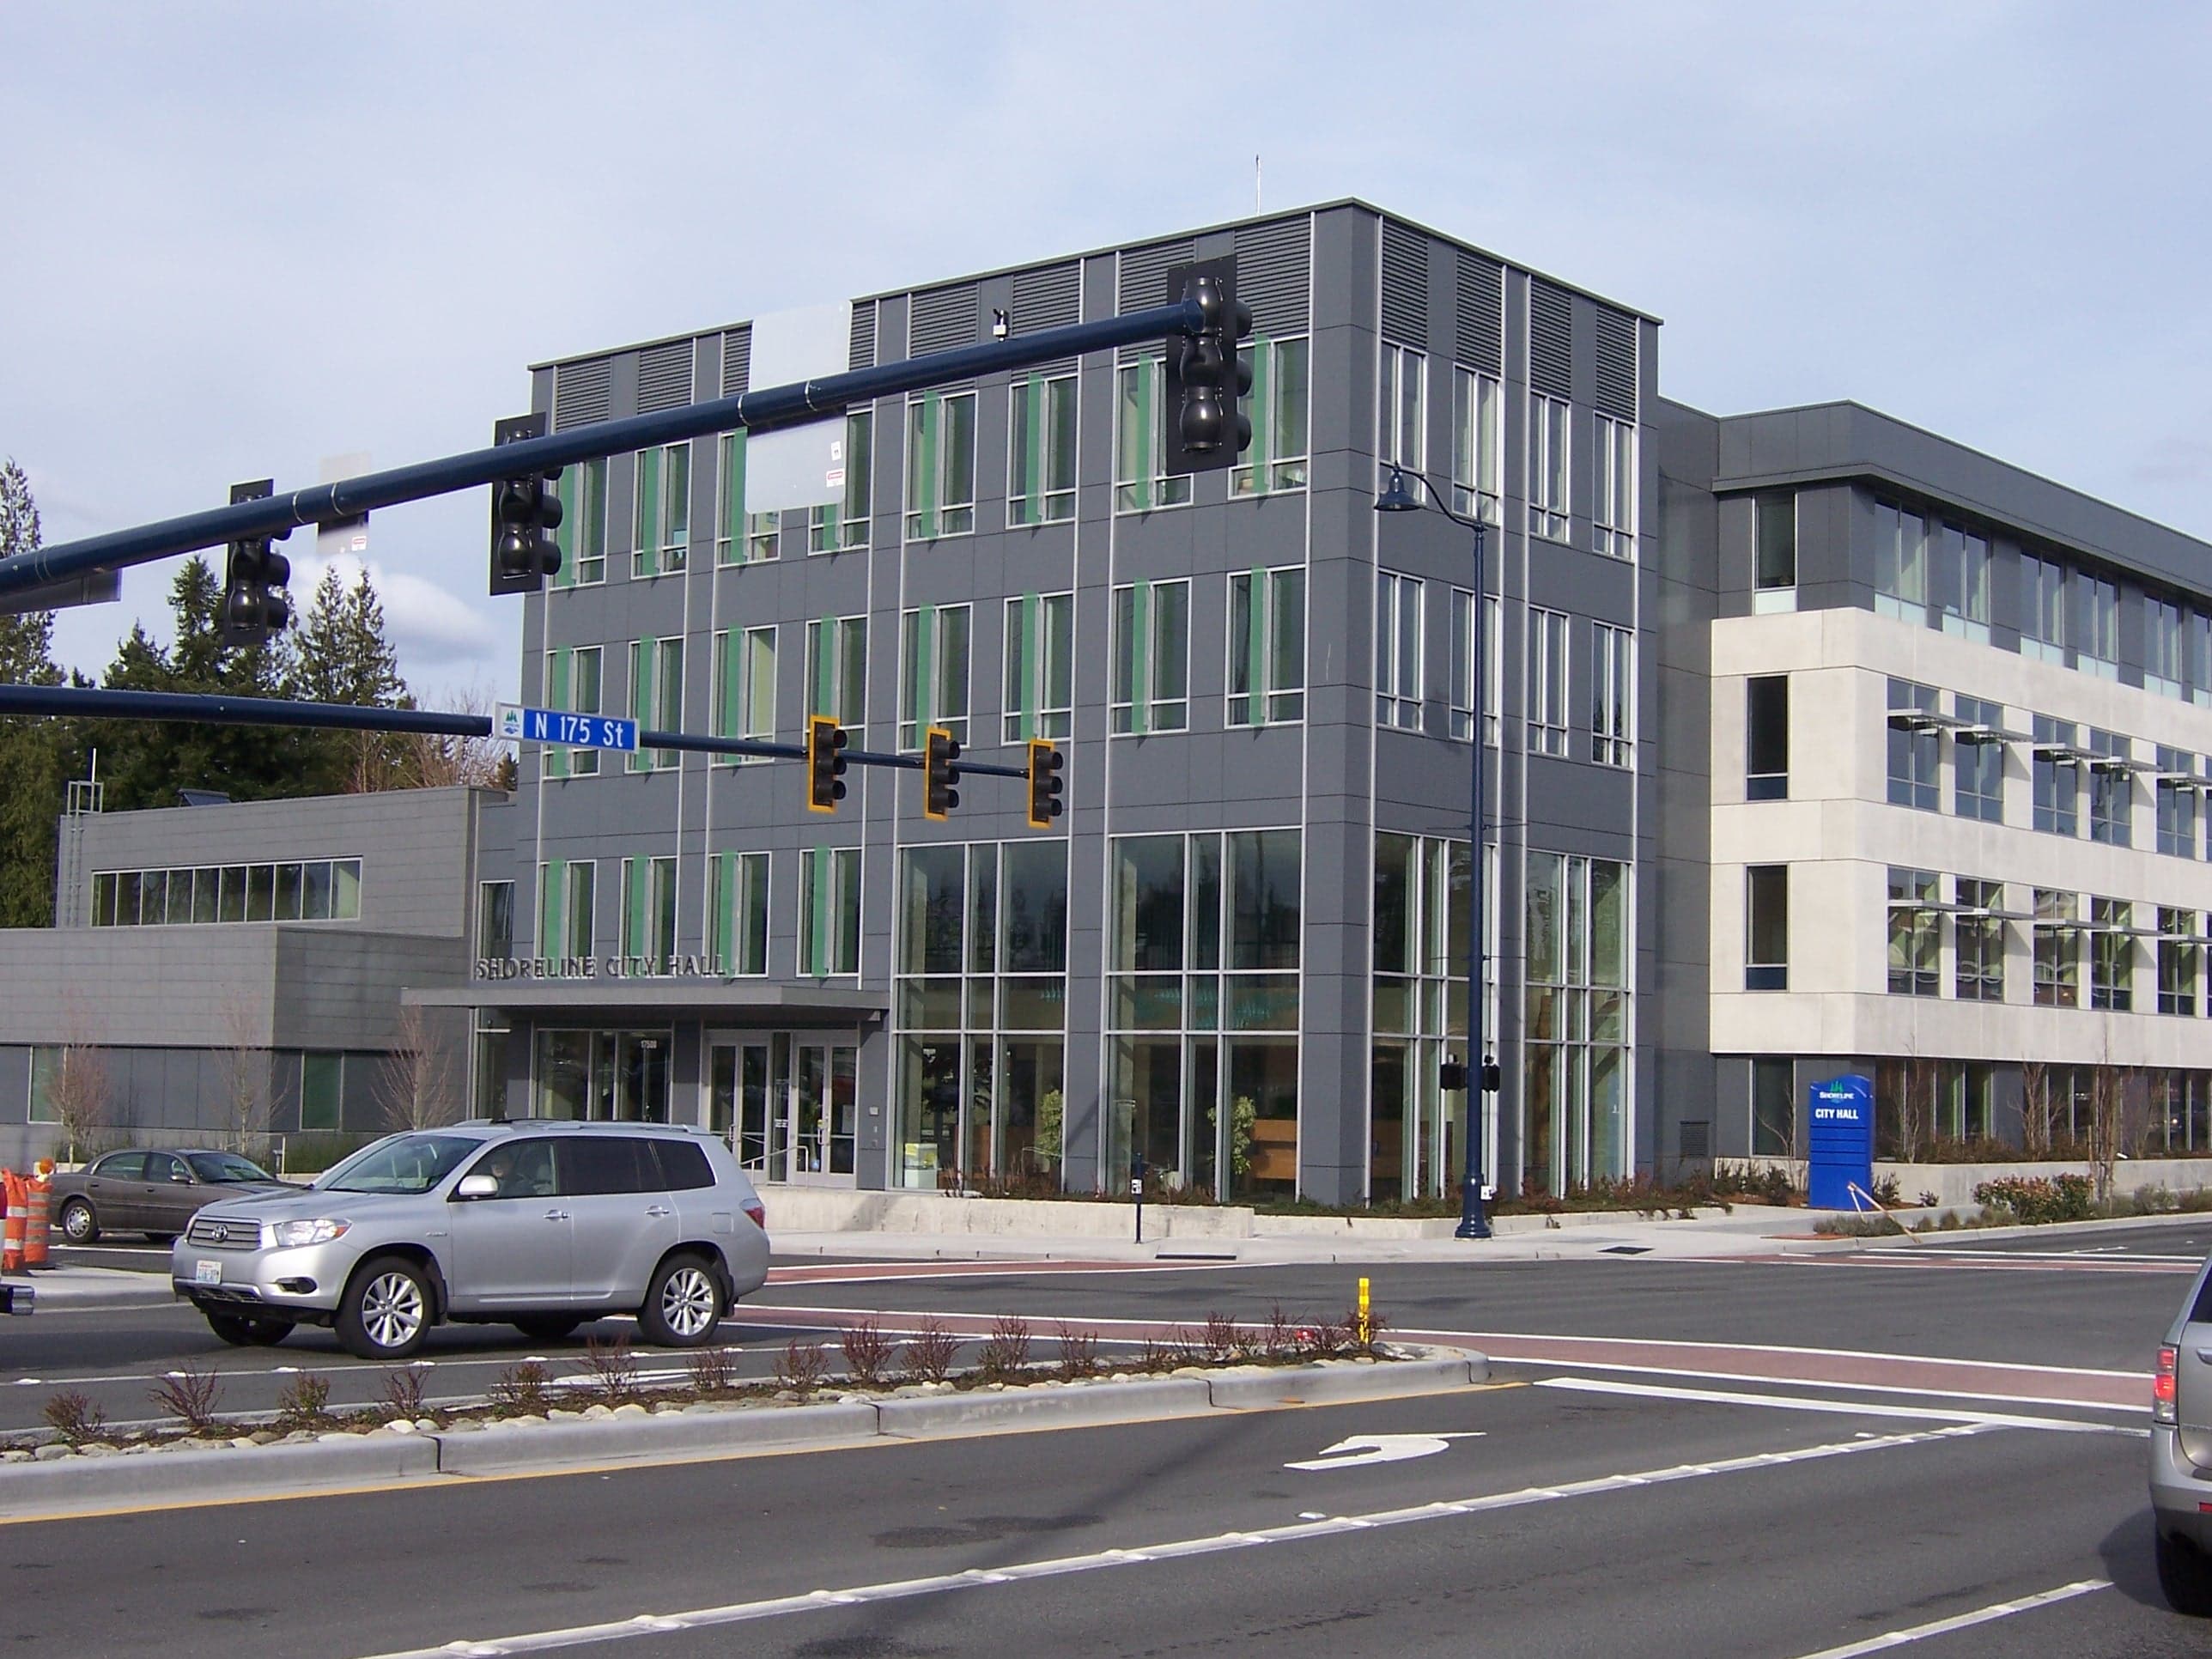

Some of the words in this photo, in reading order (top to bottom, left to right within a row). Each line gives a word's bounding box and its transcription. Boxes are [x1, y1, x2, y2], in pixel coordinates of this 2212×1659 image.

[535, 712, 548, 739] N
[560, 715, 591, 744] 175
[603, 720, 623, 748] St
[476, 955, 598, 981] SHORELINE
[606, 955, 659, 977] CITY
[668, 954, 726, 978] HALL
[1815, 1108, 1835, 1119] CITY
[1836, 1108, 1859, 1120] HALL
